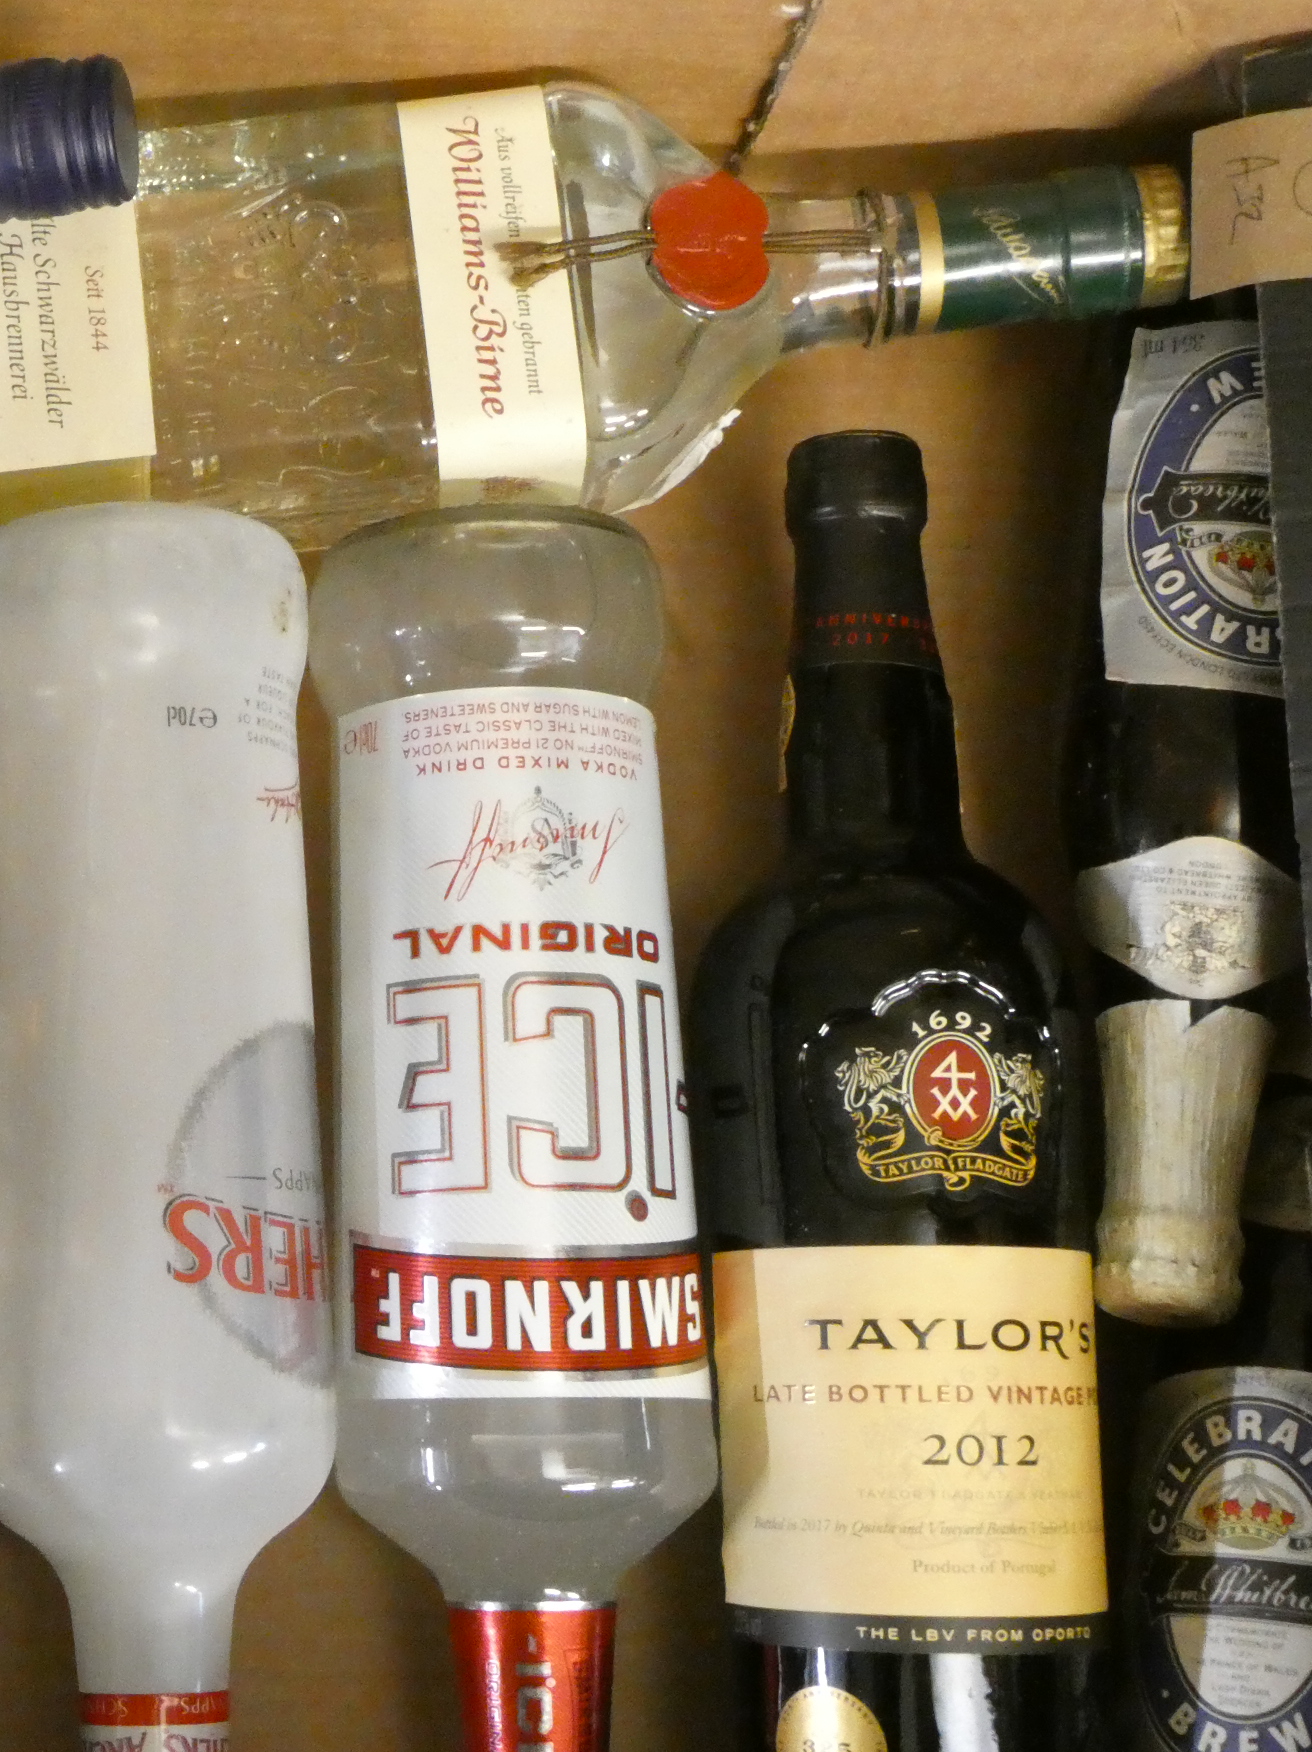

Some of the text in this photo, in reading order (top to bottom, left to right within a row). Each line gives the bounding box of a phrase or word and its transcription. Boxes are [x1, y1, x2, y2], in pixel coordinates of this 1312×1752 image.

[494, 126, 510, 162] Aus
[498, 165, 527, 239] vollreifen
[445, 115, 509, 419] Williams-Birne
[85, 265, 110, 352] Seit 1844
[32, 254, 72, 429] Schwarzwälder
[513, 321, 544, 396] gebrannt
[1142, 541, 1272, 655] RATION
[500, 701, 531, 715] AND
[534, 701, 581, 717] SUGAR
[581, 706, 611, 721] WITH
[401, 728, 421, 743] OF
[423, 719, 471, 739] TASTE
[475, 718, 545, 733] CLASSIC
[548, 719, 577, 733] THE
[580, 723, 611, 740] WITH
[401, 737, 575, 760] NO 21 PREMIUM VODKA
[415, 754, 639, 782] VODKA MIXED DRINK
[393, 918, 661, 964] ORIGINAL
[910, 1009, 993, 1043] 1692
[386, 970, 680, 1223] ICE
[876, 1156, 1026, 1182] TAYLOR FLADGATE
[162, 1193, 327, 1303] HERS
[374, 1270, 705, 1356] SMIRNOFF
[804, 1317, 1092, 1361] TAYLOR'S
[752, 1383, 816, 1406] LATE
[827, 1383, 975, 1405] BOTTLED
[986, 1384, 1083, 1407] VINTAGE
[921, 1433, 1041, 1468] 2012
[1147, 1408, 1312, 1536] CELEBRA
[800, 1517, 831, 1532] 2017
[912, 1558, 976, 1576] Product
[980, 1557, 997, 1576] of
[855, 1625, 1091, 1642] THE LBV FROM OPORTO
[487, 1658, 504, 1752] ORIGIN
